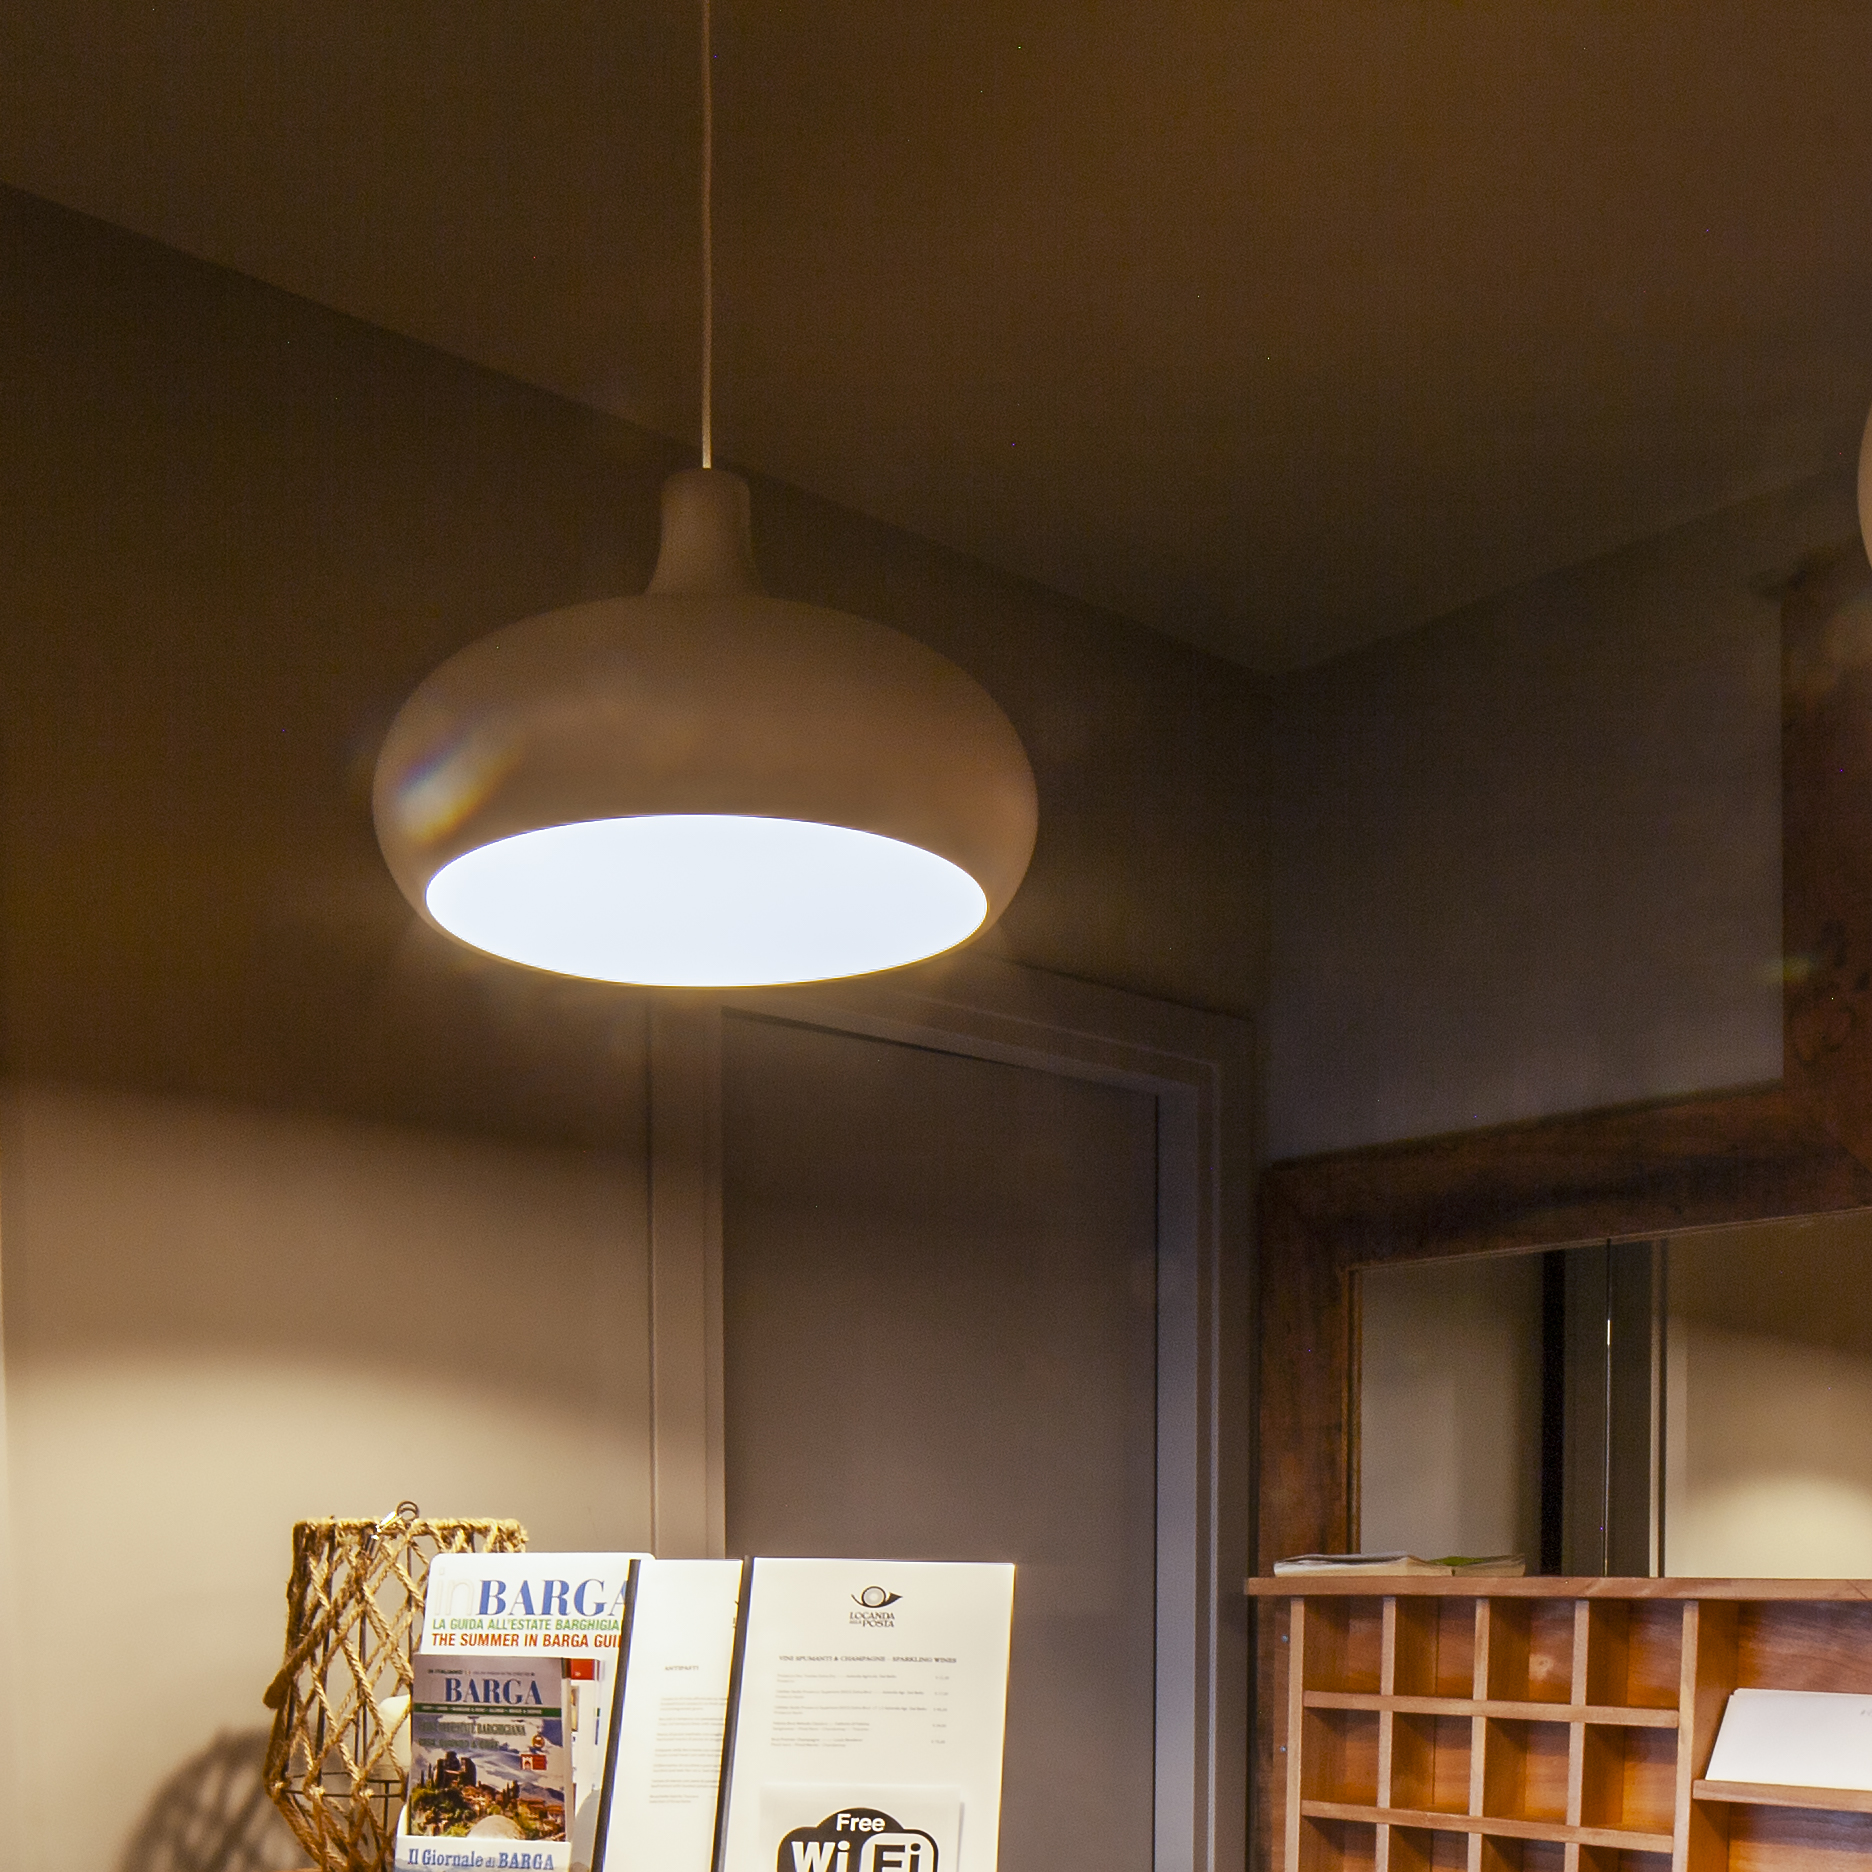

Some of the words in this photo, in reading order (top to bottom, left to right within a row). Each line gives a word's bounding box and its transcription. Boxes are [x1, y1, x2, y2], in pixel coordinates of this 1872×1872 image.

[849, 1611, 896, 1620] LOCANDA
[862, 1619, 895, 1628] POSTA
[432, 1618, 446, 1630] LA
[450, 1618, 484, 1631] GUIDA
[487, 1618, 552, 1631] ALL'ESTATE
[432, 1633, 456, 1647] THE
[459, 1633, 520, 1648] SUMMER
[524, 1633, 539, 1648] IN
[542, 1634, 589, 1649] BARGA
[444, 1677, 543, 1705] BARGA
[836, 1813, 886, 1832] Free
[408, 1848, 418, 1865] Il
[422, 1849, 484, 1868] Giornale
[485, 1856, 496, 1868] di
[497, 1852, 554, 1871] BARGA
